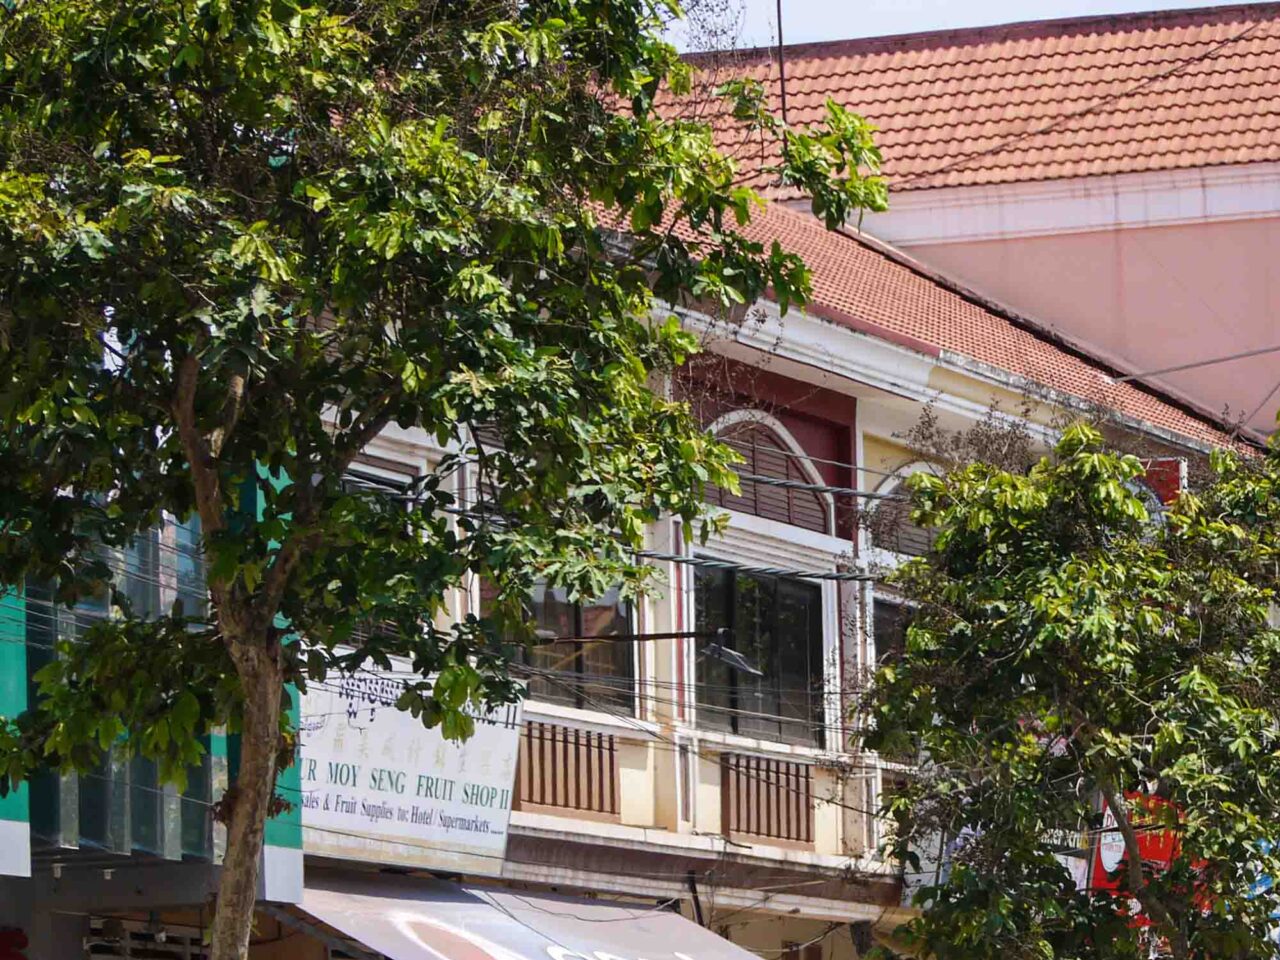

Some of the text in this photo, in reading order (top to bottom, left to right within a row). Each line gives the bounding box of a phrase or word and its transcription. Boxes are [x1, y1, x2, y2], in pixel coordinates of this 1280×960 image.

[327, 762, 361, 788] MOY
[369, 767, 407, 794] SENG
[416, 774, 456, 802] FRUIT
[462, 782, 498, 809] SHOP
[323, 793, 330, 811] &
[334, 794, 357, 814] Fruit
[360, 799, 394, 823] Supplies
[410, 805, 433, 825] Hotel
